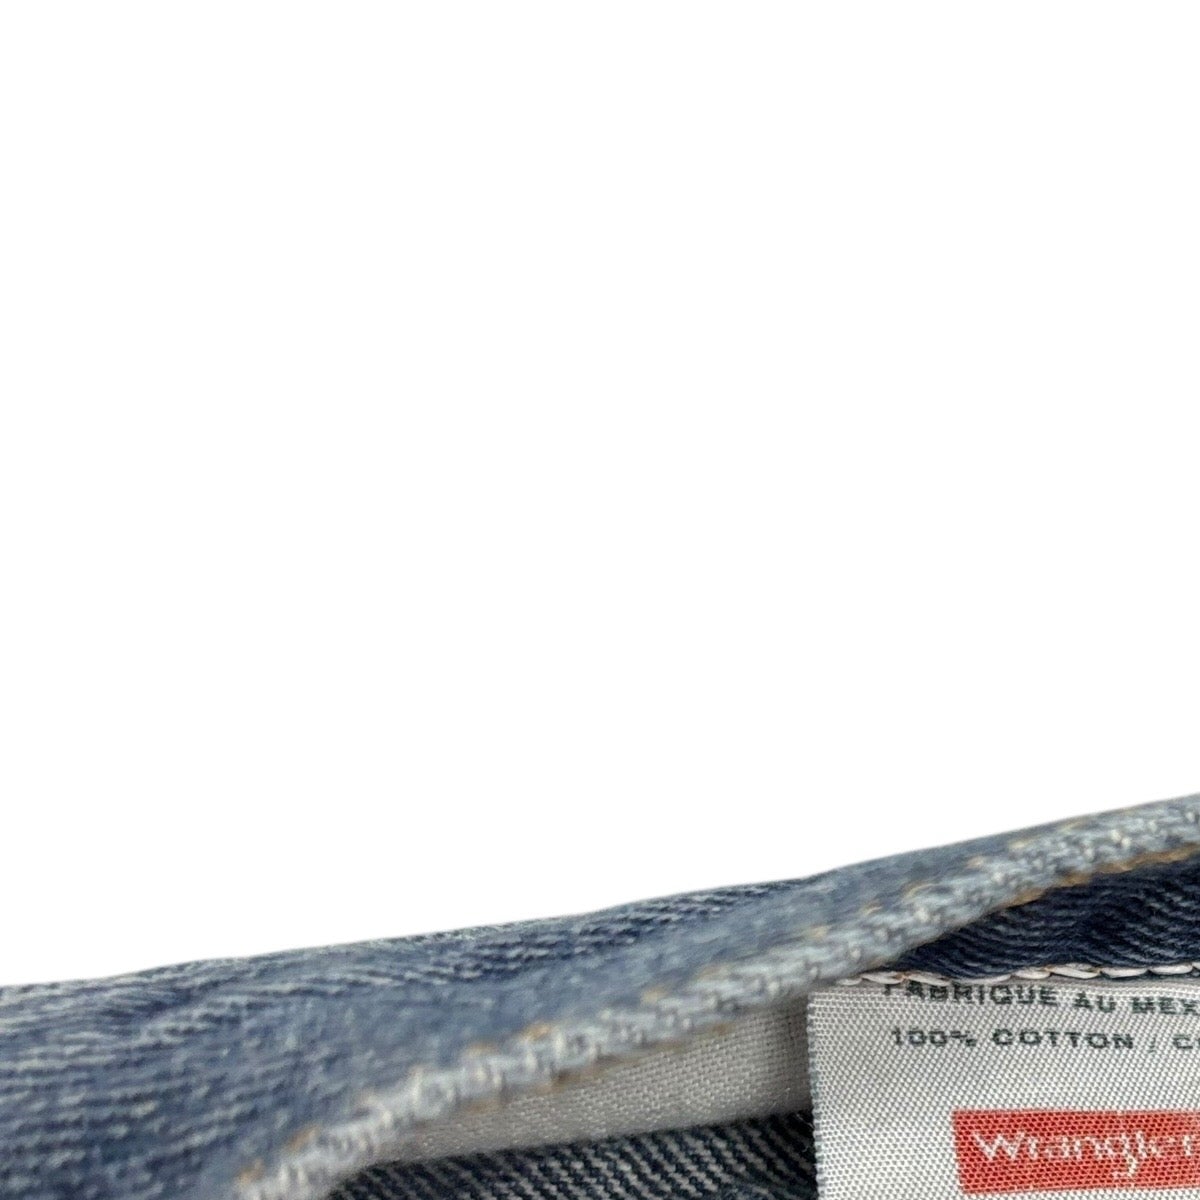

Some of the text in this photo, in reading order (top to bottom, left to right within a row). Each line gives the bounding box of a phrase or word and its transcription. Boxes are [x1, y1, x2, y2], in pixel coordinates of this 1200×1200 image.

[1073, 992, 1116, 1013] AU
[892, 1029, 976, 1047] 100%
[993, 1028, 1134, 1049] COTTON
[972, 1130, 1198, 1179] Wrangler
